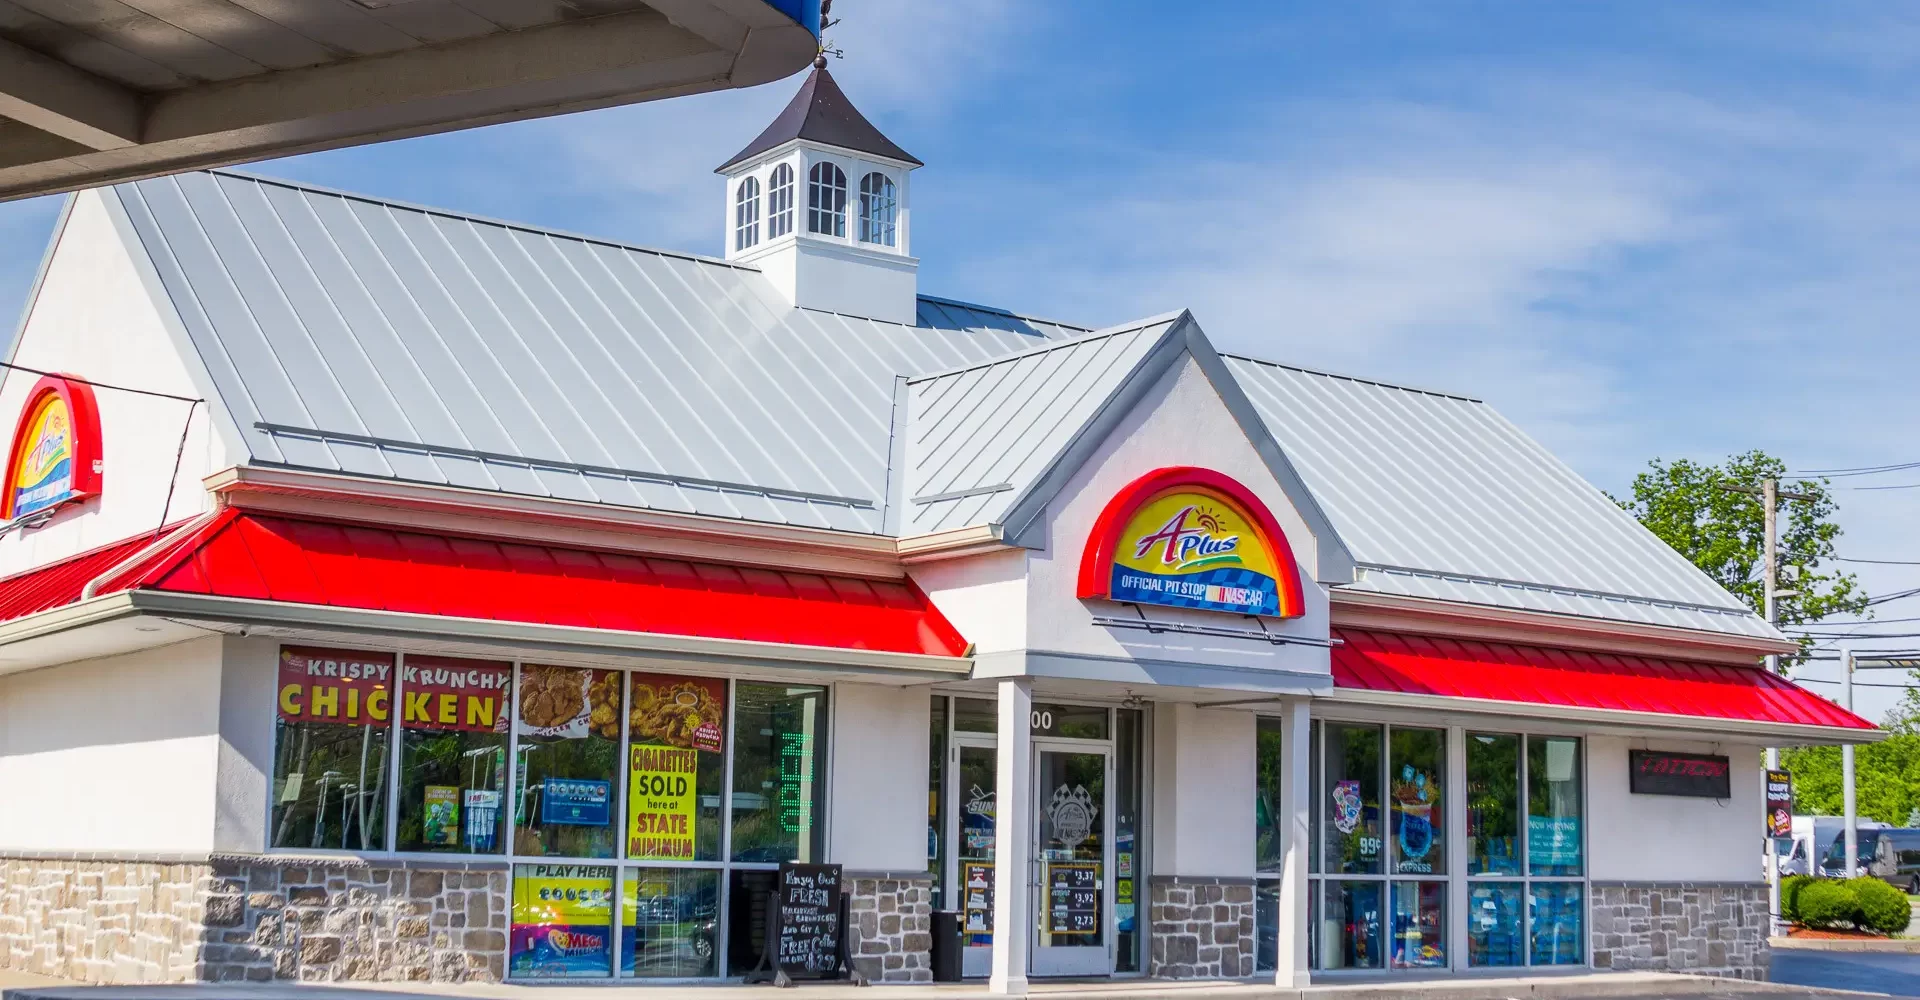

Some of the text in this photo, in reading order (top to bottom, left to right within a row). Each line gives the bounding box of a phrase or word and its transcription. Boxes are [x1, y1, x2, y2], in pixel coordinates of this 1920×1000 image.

[836, 49, 844, 60] E
[1121, 574, 1263, 607] OFFICIAL PIT STOP NASCAR
[306, 659, 390, 681] KRISPY
[403, 665, 511, 690] KRUNCHY
[632, 747, 697, 774] CIGARETTES
[639, 775, 688, 797] SOLD
[781, 732, 814, 832] OPEN
[647, 798, 679, 809] here at
[970, 801, 997, 812] SUN
[637, 812, 688, 835] STATE
[1546, 821, 1576, 831] HIRING
[630, 837, 694, 858] MINIMUM
[1360, 837, 1382, 855] 99¢
[535, 865, 576, 877] PLAY
[786, 869, 814, 888] Enjoy
[790, 887, 829, 907] FRESH
[567, 933, 603, 949] MEGA
[780, 936, 811, 955] FREE
